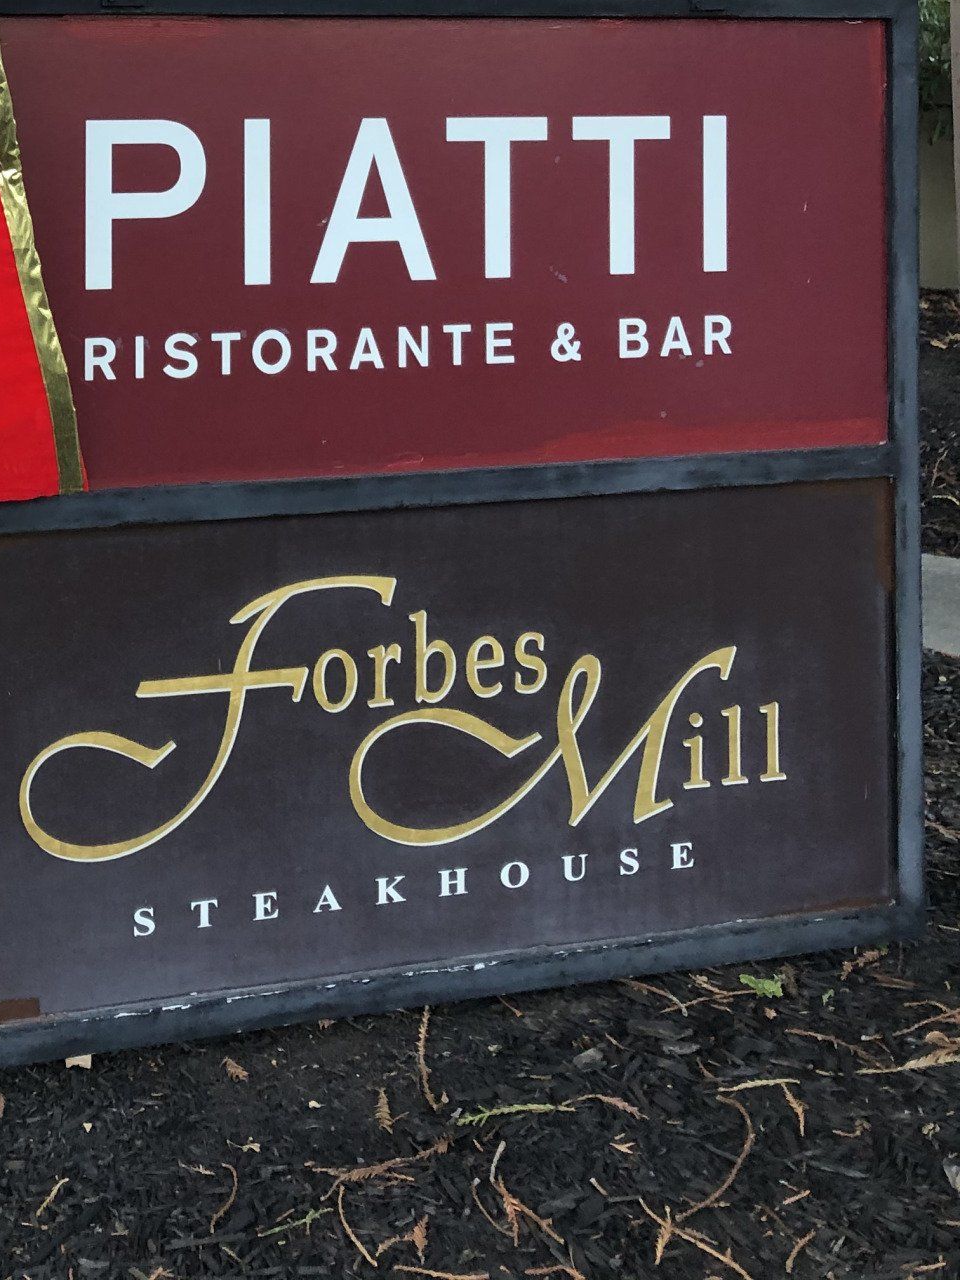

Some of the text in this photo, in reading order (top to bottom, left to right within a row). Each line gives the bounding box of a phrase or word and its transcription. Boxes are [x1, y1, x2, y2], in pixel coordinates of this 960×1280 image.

[84, 114, 729, 292] PIATTI
[83, 313, 734, 383] RISTORANTE & BAR
[18, 574, 549, 864] Forbes
[348, 645, 789, 848] Mill
[133, 840, 696, 939] STEAKHOUSE
